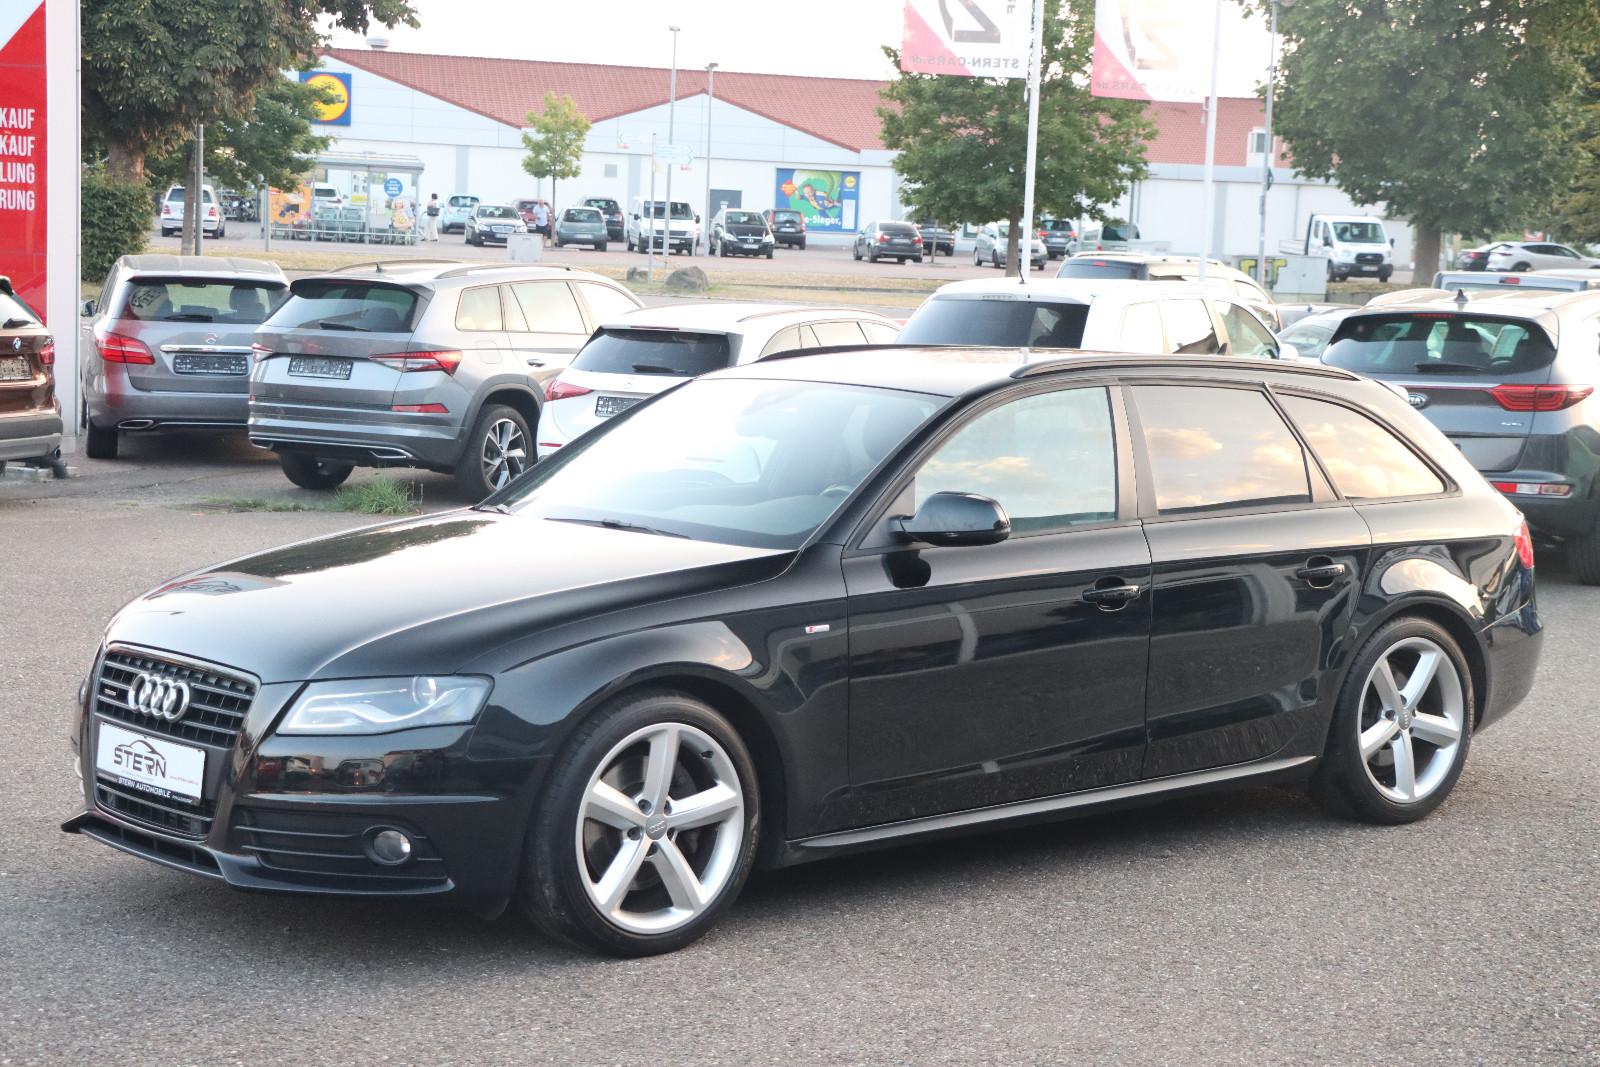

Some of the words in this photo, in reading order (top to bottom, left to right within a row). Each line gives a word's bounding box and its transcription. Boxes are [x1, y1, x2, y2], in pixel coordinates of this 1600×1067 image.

[0, 108, 36, 129] KAUF
[0, 135, 36, 156] KAUF
[0, 162, 36, 184] LUNG
[0, 189, 36, 211] RUNG
[113, 746, 167, 779] STERN
[118, 777, 135, 788] STERN
[135, 782, 172, 799] AUTOMOBILE
